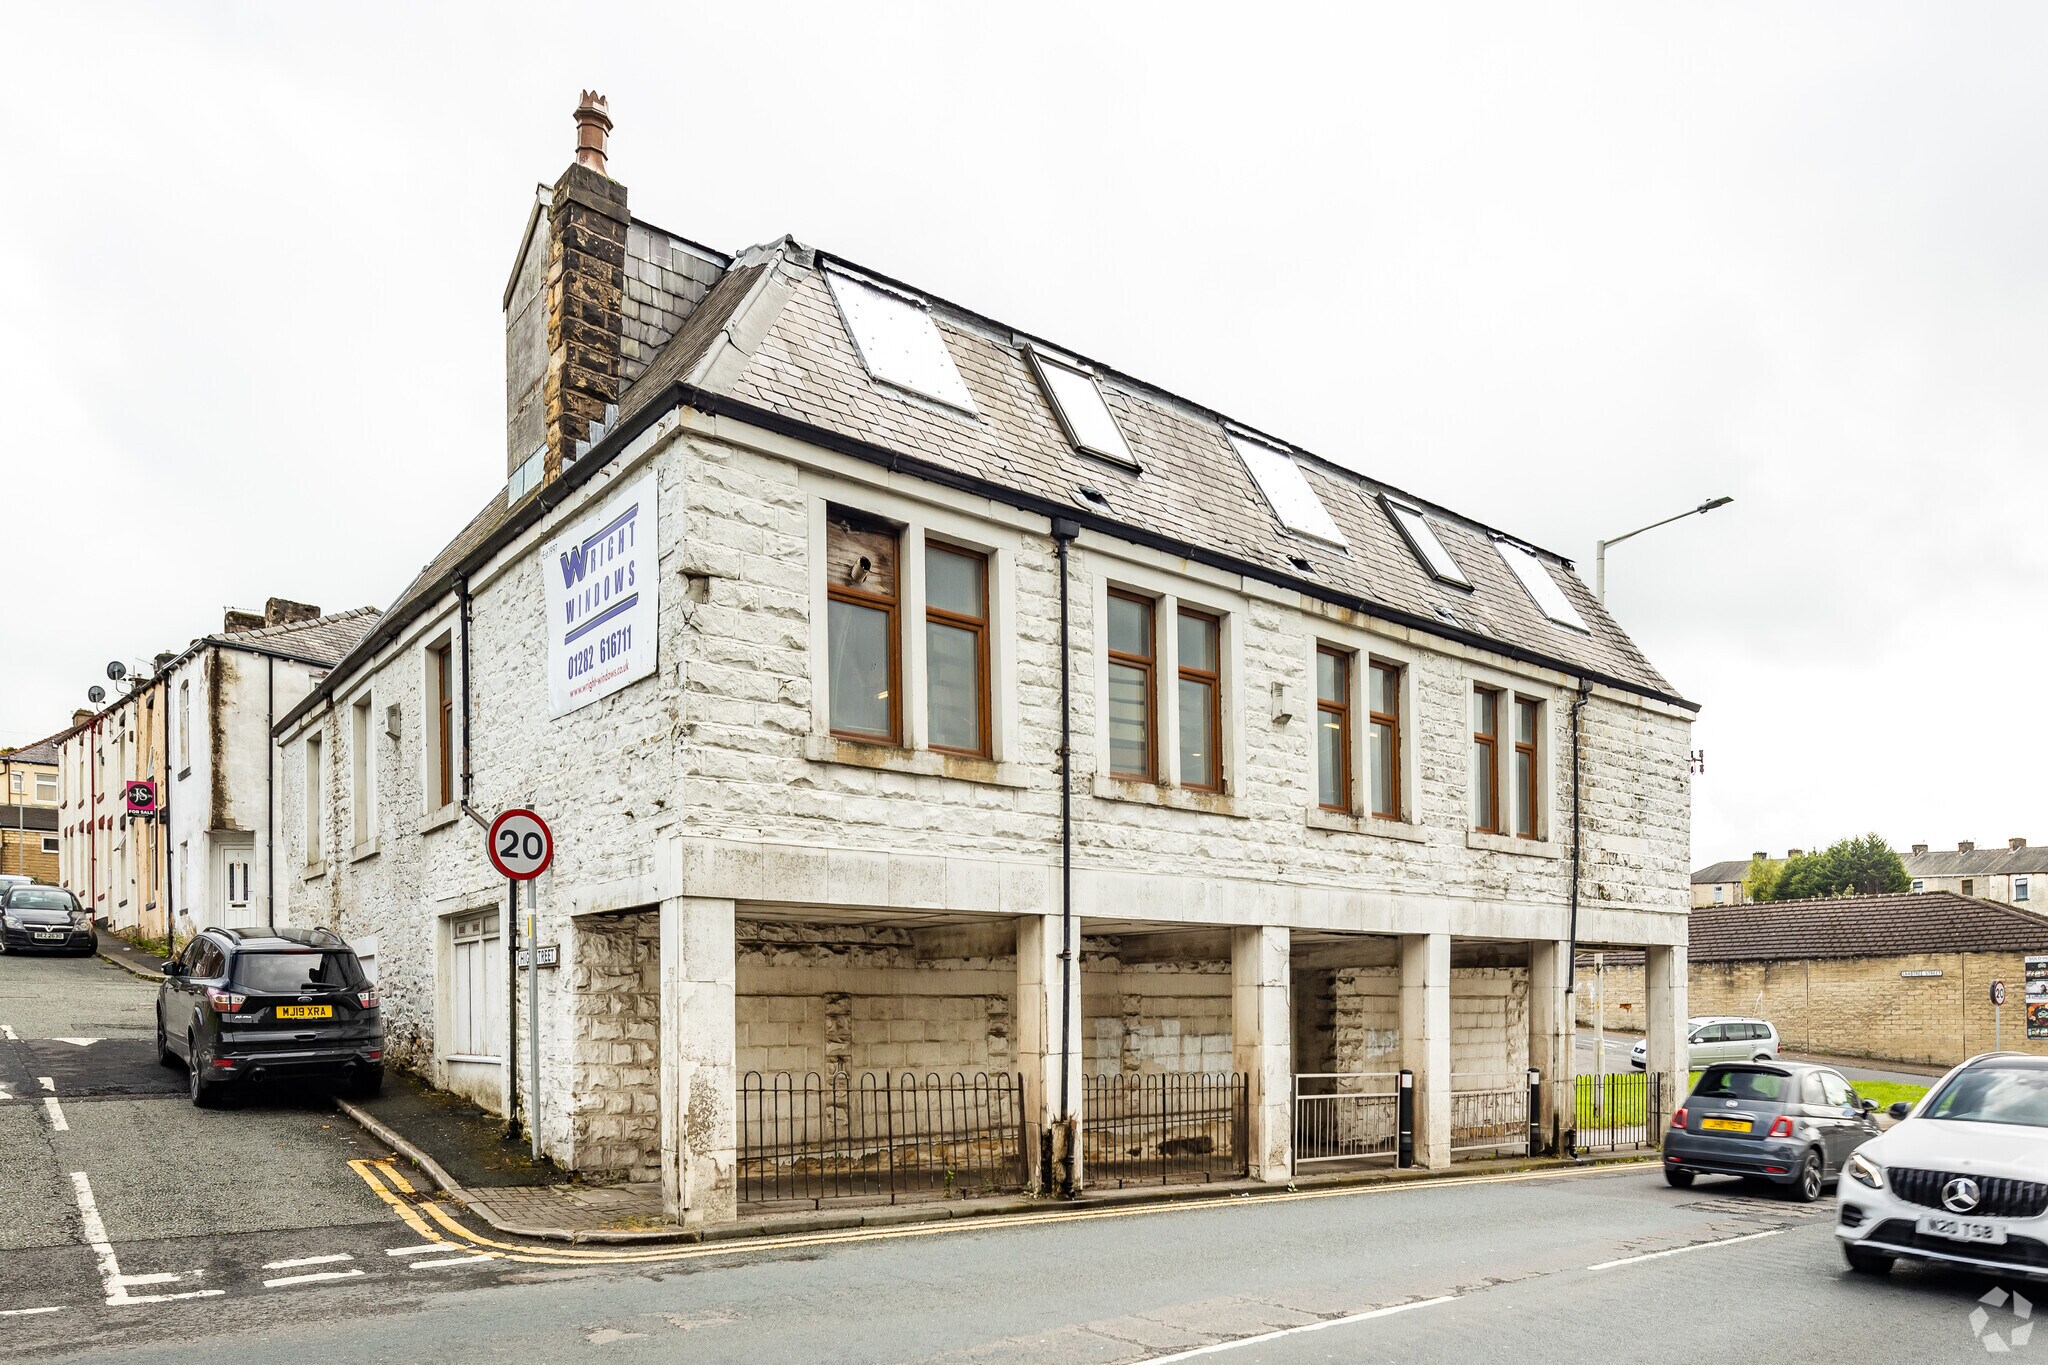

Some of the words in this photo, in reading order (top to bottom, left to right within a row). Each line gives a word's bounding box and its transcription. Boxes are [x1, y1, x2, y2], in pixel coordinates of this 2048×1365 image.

[560, 520, 636, 589] WRIGHT
[565, 559, 635, 624] WINDOWS
[568, 645, 594, 680] 01282
[599, 624, 632, 663] 616711
[569, 659, 630, 697] www.wright-windows.co.uk
[499, 829, 543, 860] 20
[537, 948, 554, 963] TREET
[282, 1007, 305, 1016] MJ19
[307, 1006, 326, 1016] XRA
